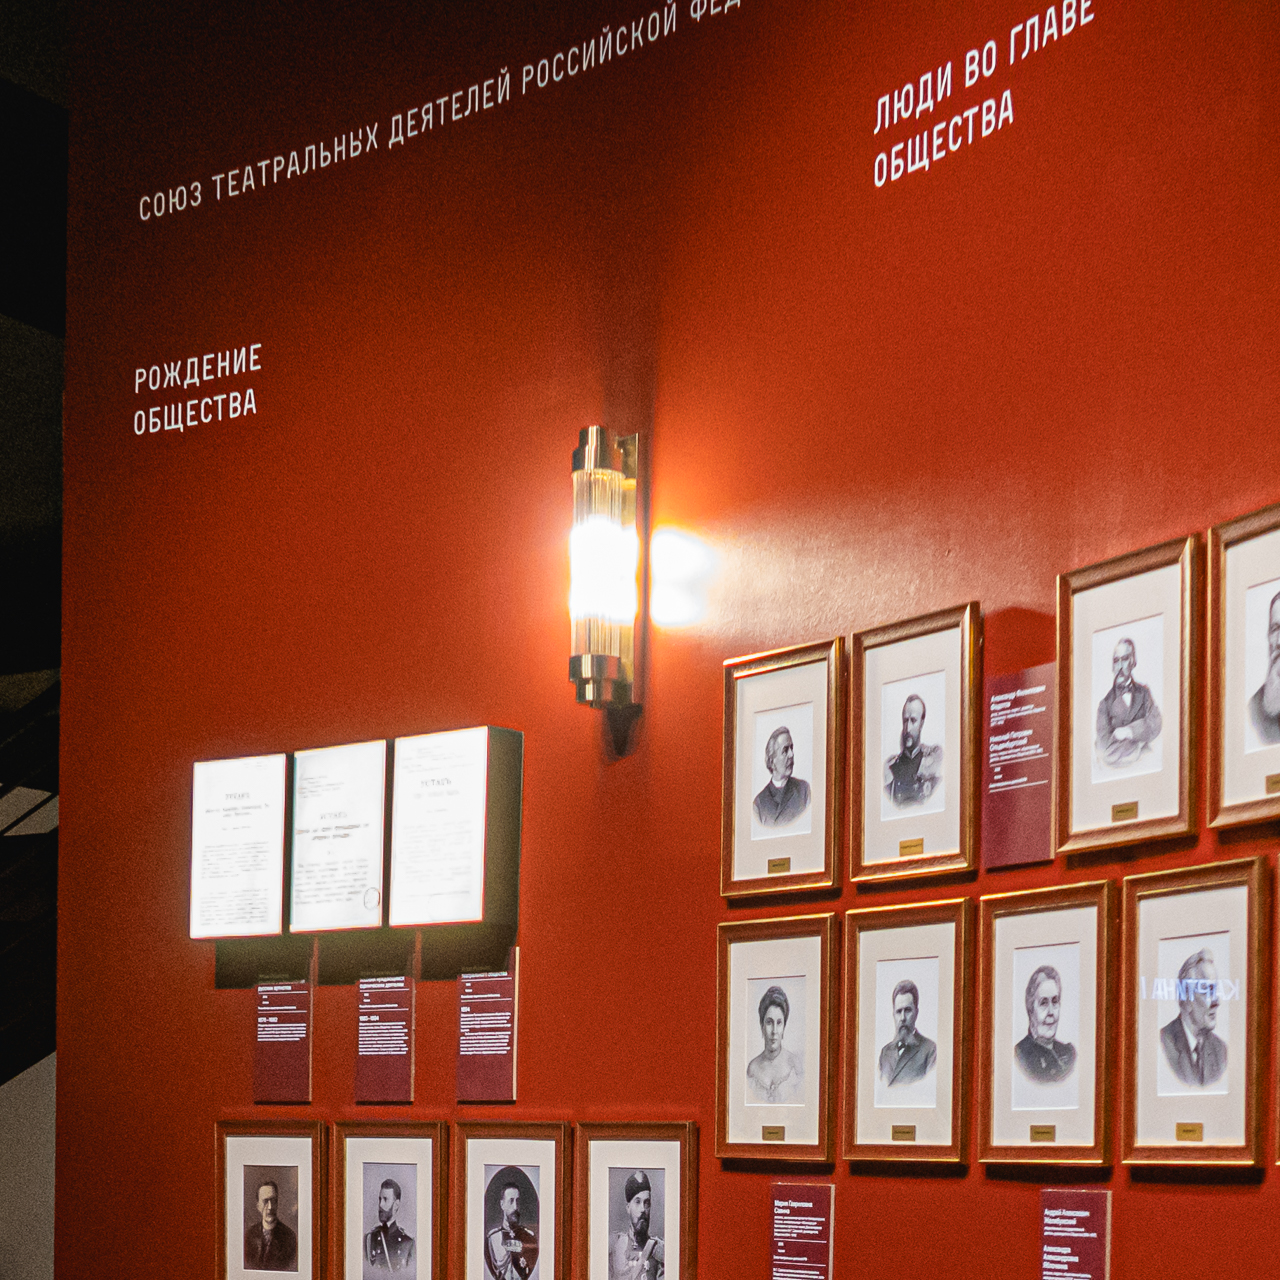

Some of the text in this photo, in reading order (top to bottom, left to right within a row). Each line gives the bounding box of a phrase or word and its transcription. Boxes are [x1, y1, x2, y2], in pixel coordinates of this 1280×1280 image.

[139, 181, 202, 221] СОЮЗ
[211, 122, 379, 201] ТЕАТРАЛЬНЫХ
[388, 66, 511, 149] ДЕЯТЕЛЕЙ
[521, 0, 677, 95] РОССИЙСКОЙ
[873, 0, 1095, 136] ЛЮДИ ВО ГЛАВЕ
[873, 88, 1014, 188] ОБЩЕСТВА
[133, 388, 257, 436] ОБЩЕСТВА
[134, 343, 262, 394] РОЖДЕНИЕ
